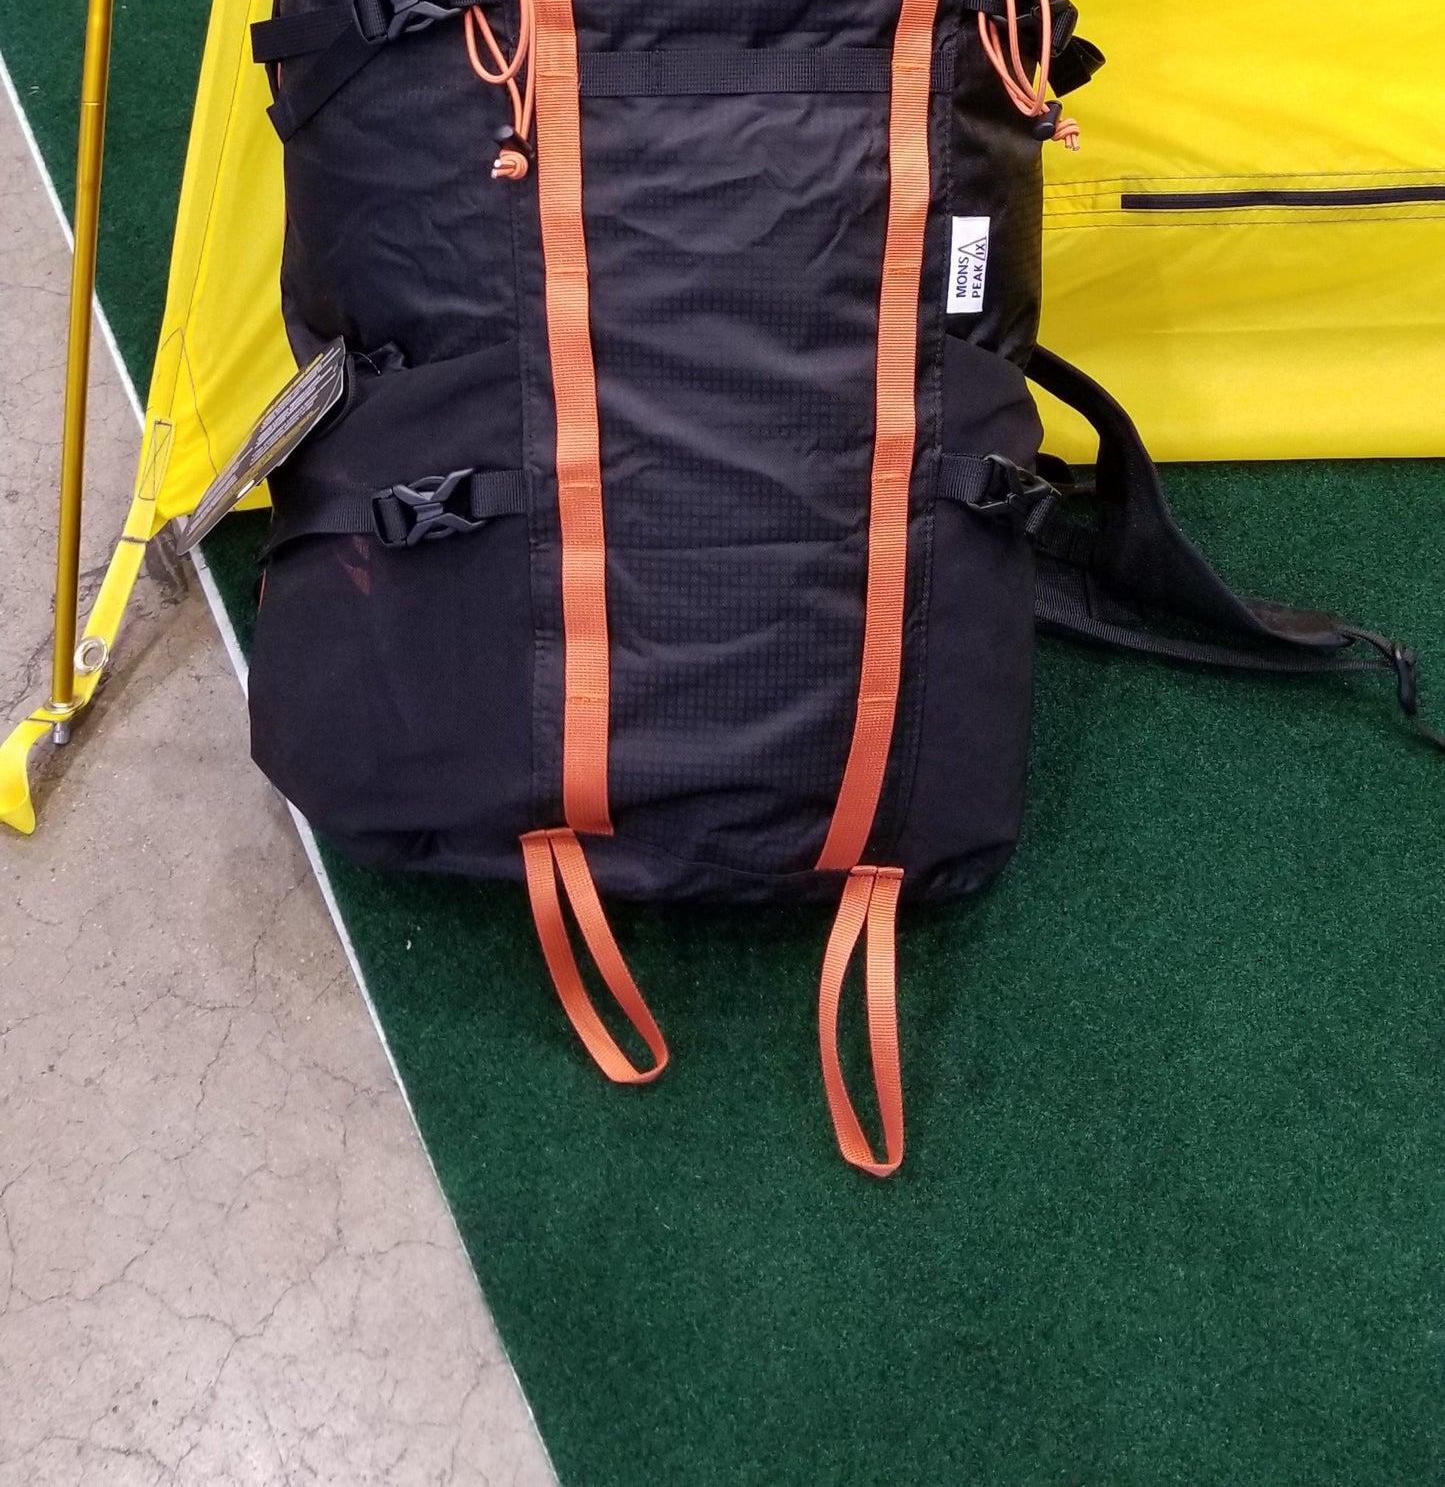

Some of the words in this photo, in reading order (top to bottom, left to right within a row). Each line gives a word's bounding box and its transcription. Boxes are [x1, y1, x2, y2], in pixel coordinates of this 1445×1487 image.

[975, 243, 986, 255] IX
[956, 256, 969, 298] MONS
[972, 264, 983, 298] PEAK
